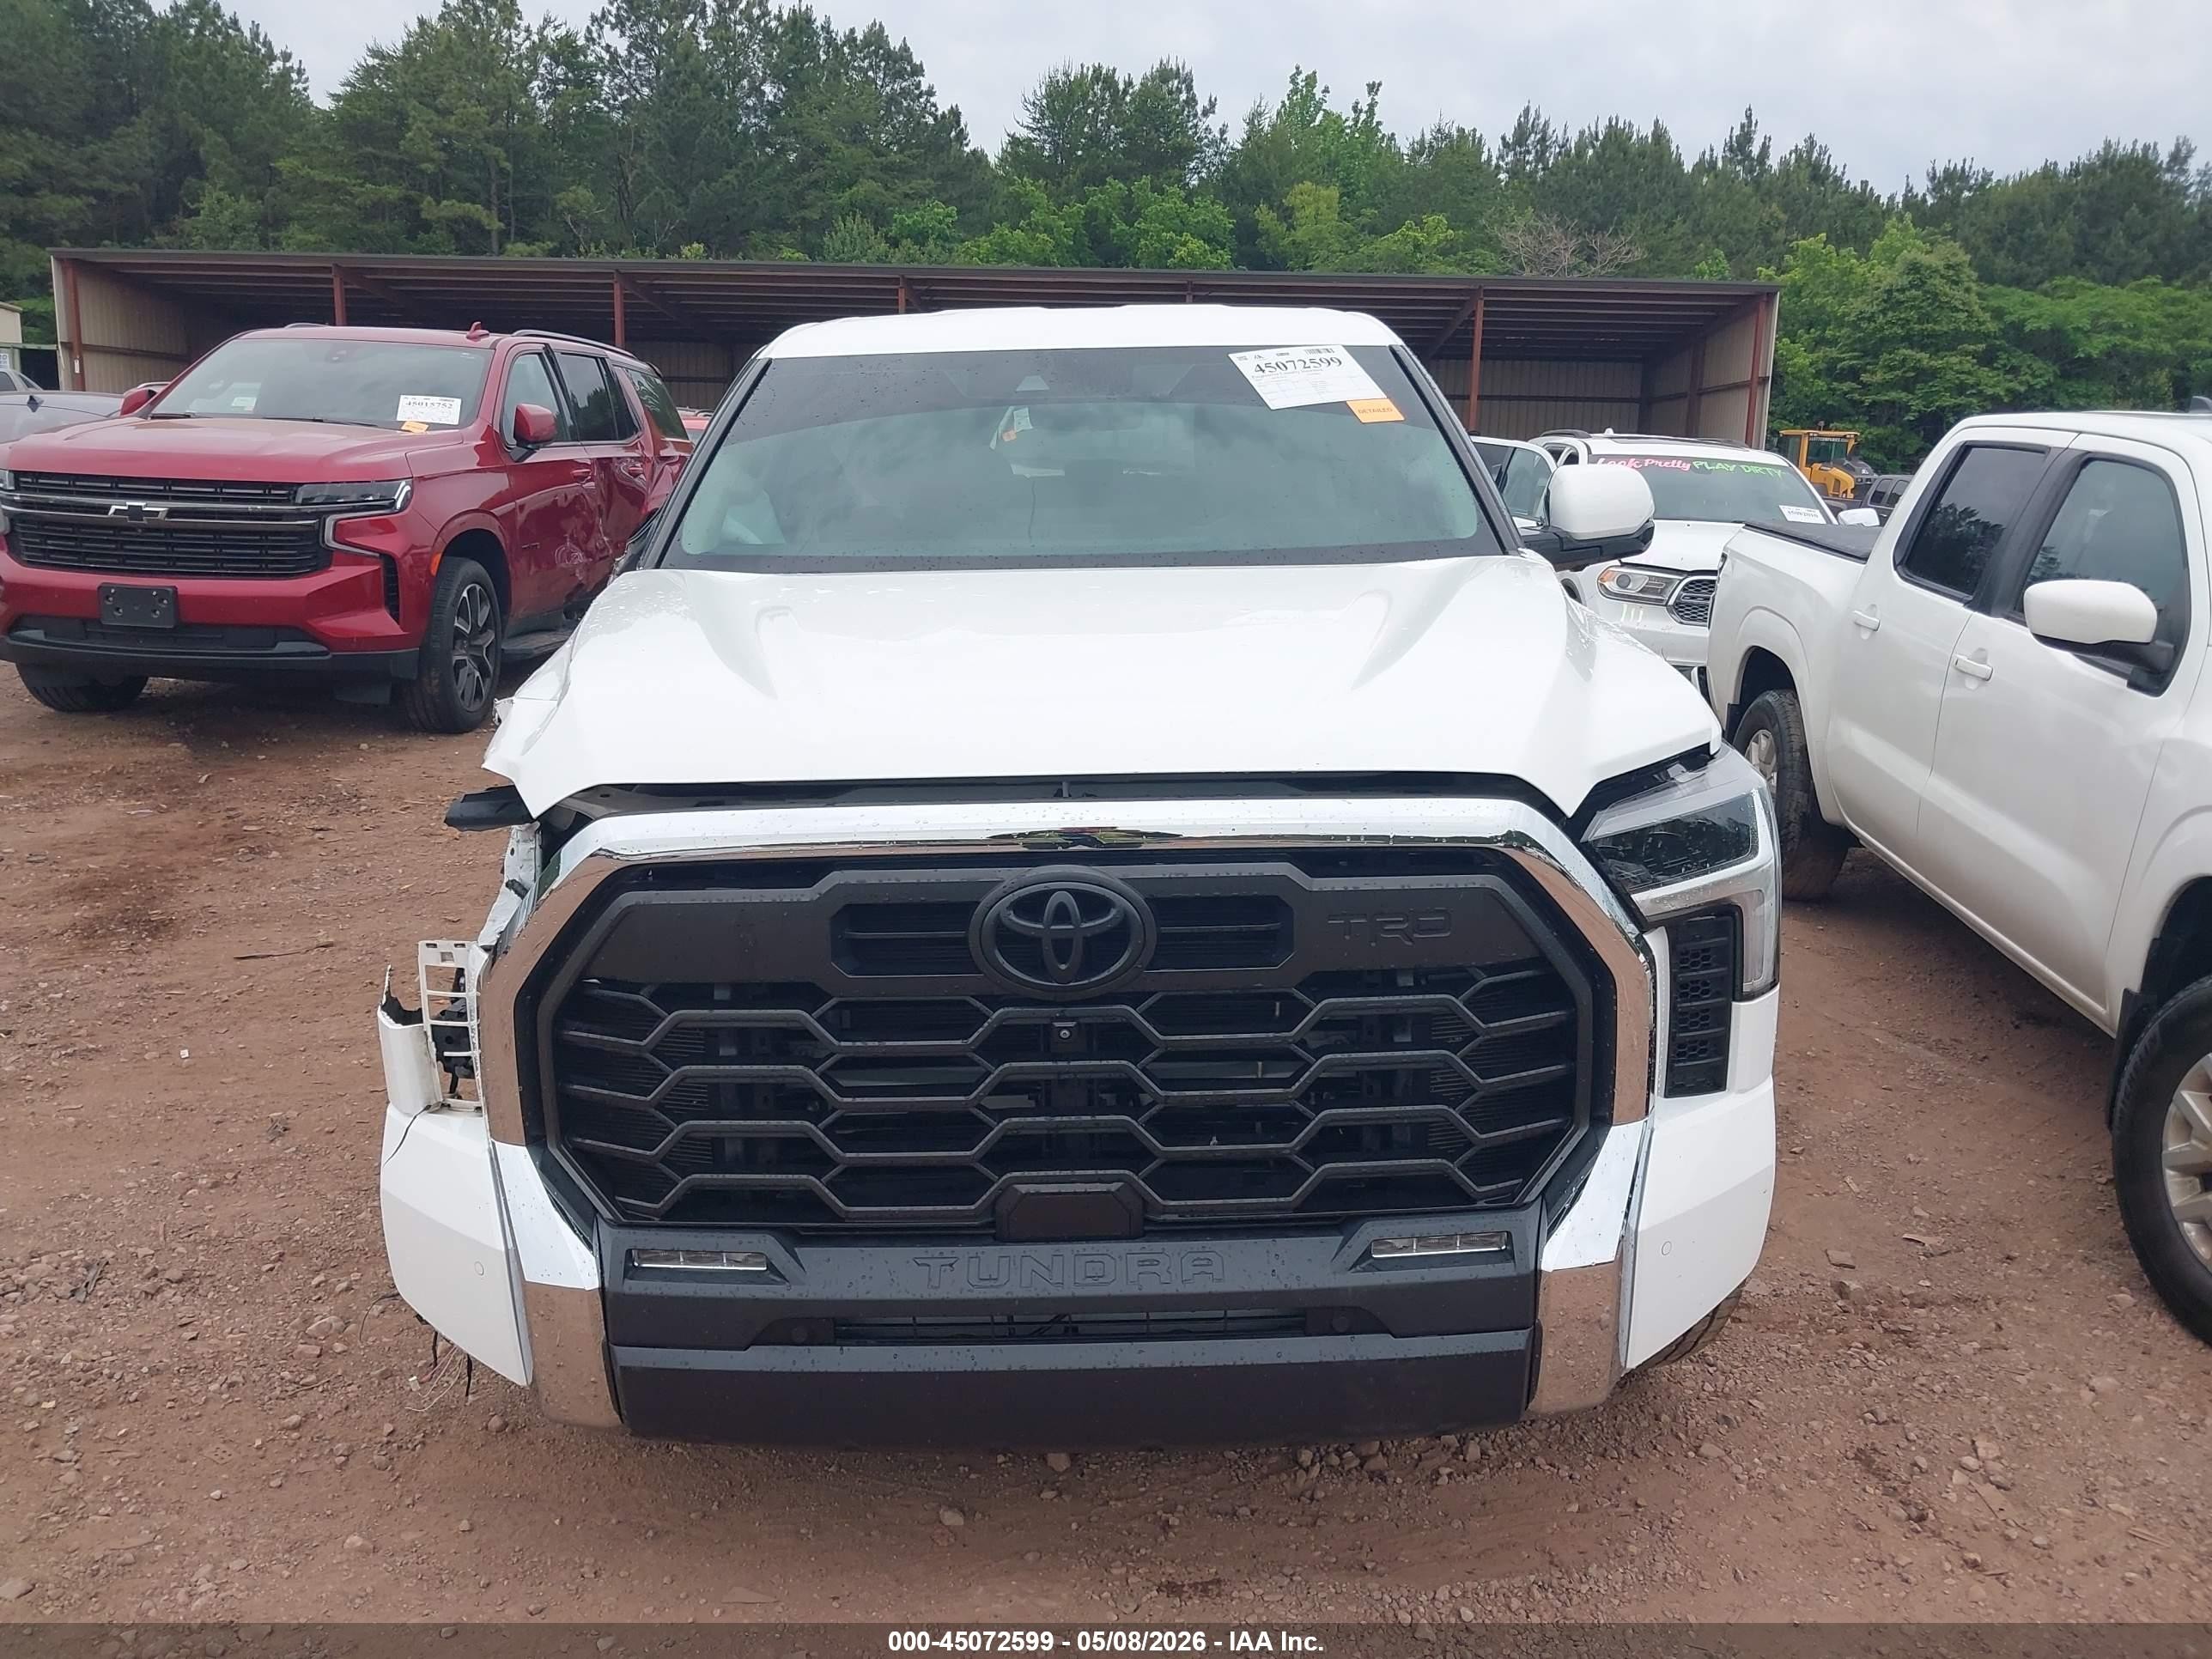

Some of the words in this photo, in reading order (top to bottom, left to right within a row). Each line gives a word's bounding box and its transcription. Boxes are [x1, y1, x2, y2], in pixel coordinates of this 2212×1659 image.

[1254, 356, 1342, 374] 45072599
[1644, 459, 1692, 471] Pretty
[1692, 461, 1737, 472] PLAY
[1737, 465, 1783, 479] DIRTY
[1328, 908, 1451, 945] TRD
[913, 1251, 1224, 1288] TUNDRA
